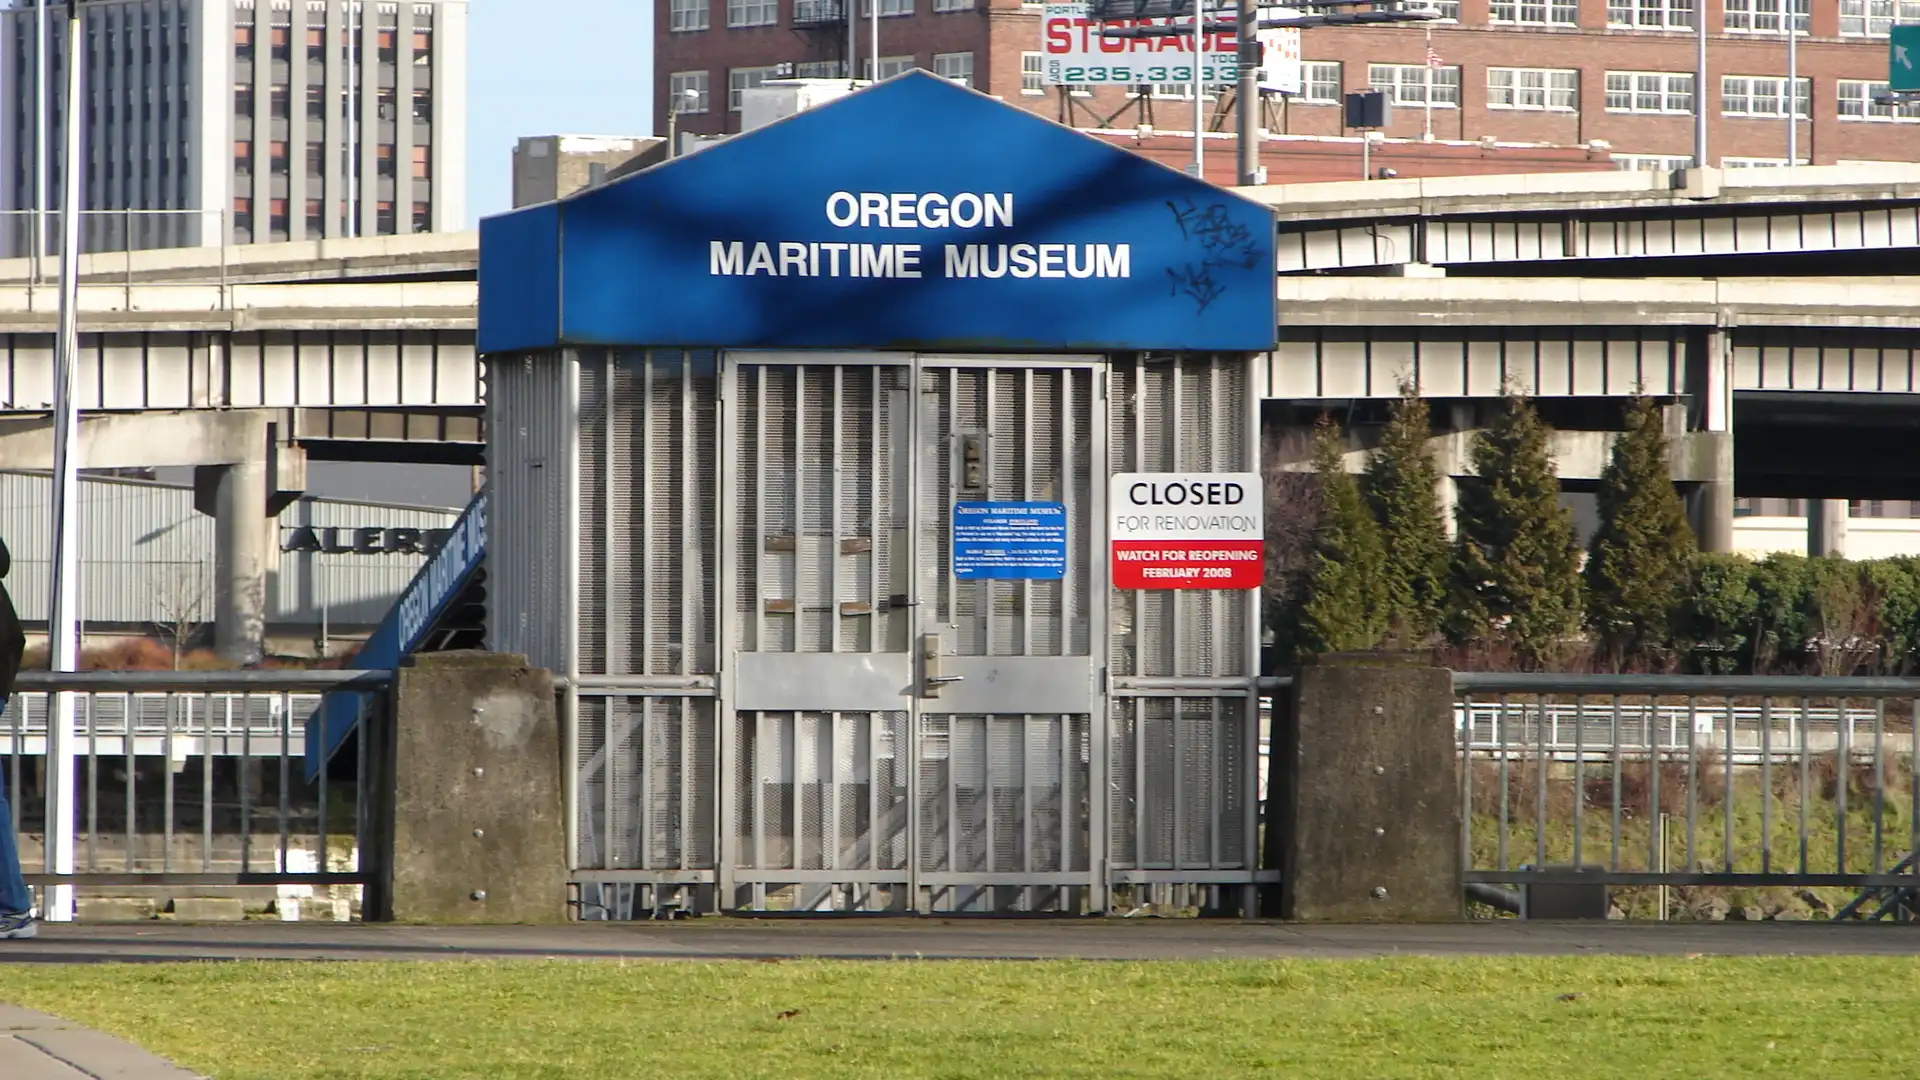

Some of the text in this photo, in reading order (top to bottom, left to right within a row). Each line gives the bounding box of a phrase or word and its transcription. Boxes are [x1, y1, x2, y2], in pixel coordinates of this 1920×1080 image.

[1047, 17, 1238, 54] STORAGE
[826, 191, 1013, 228] OREGON
[710, 241, 1130, 279] MARITIME MUSEUM
[1129, 482, 1244, 505] CLOSED
[1117, 516, 1256, 531] FOR RENOVATION
[1117, 550, 1258, 561] WATCH FOR REOPENING
[1143, 568, 1232, 578] FEBRUARY 2008
